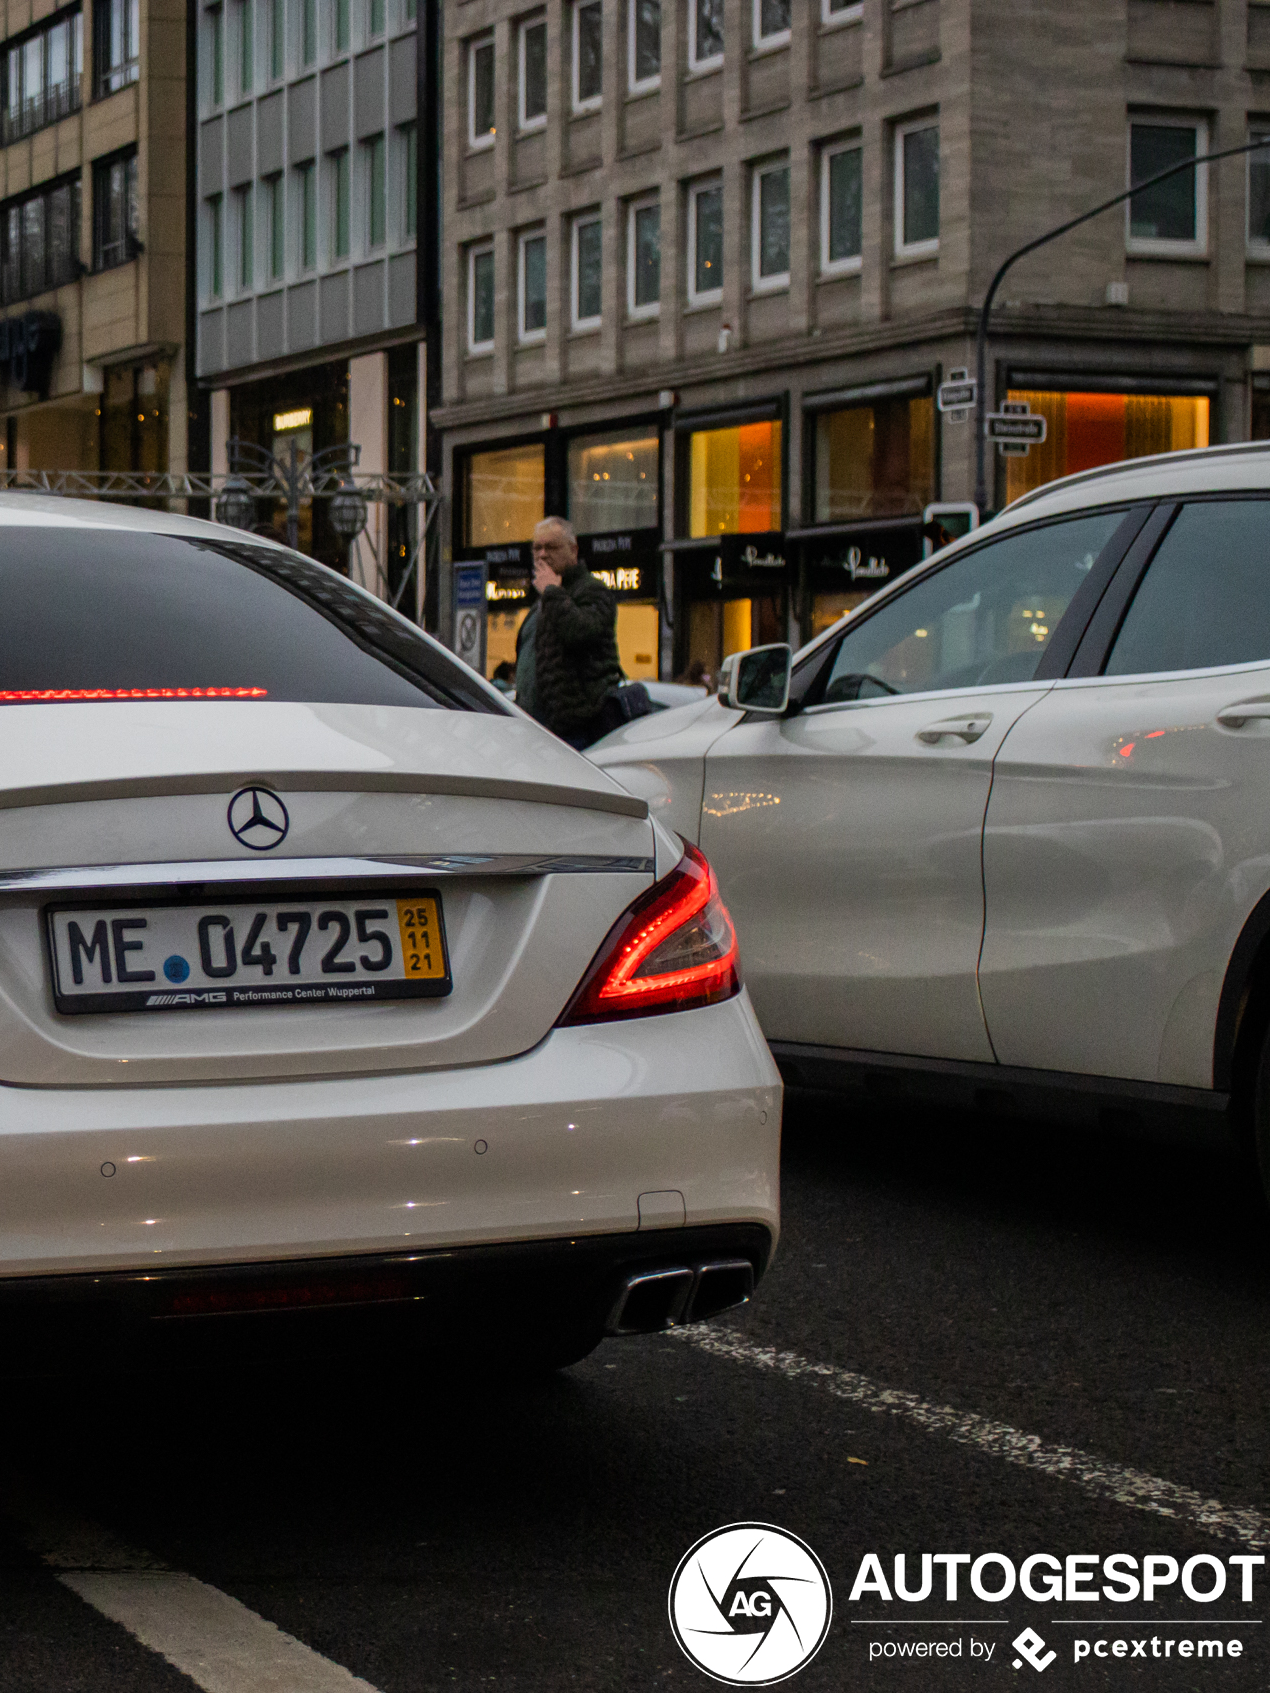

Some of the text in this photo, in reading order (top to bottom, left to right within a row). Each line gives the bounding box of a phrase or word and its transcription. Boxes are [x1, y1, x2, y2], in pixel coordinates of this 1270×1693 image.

[403, 908, 429, 928] 25
[67, 908, 393, 985] ME 04725
[407, 930, 432, 950] 11
[409, 953, 433, 971] 21
[173, 985, 375, 1005] AMG Performance Center Wuppertal
